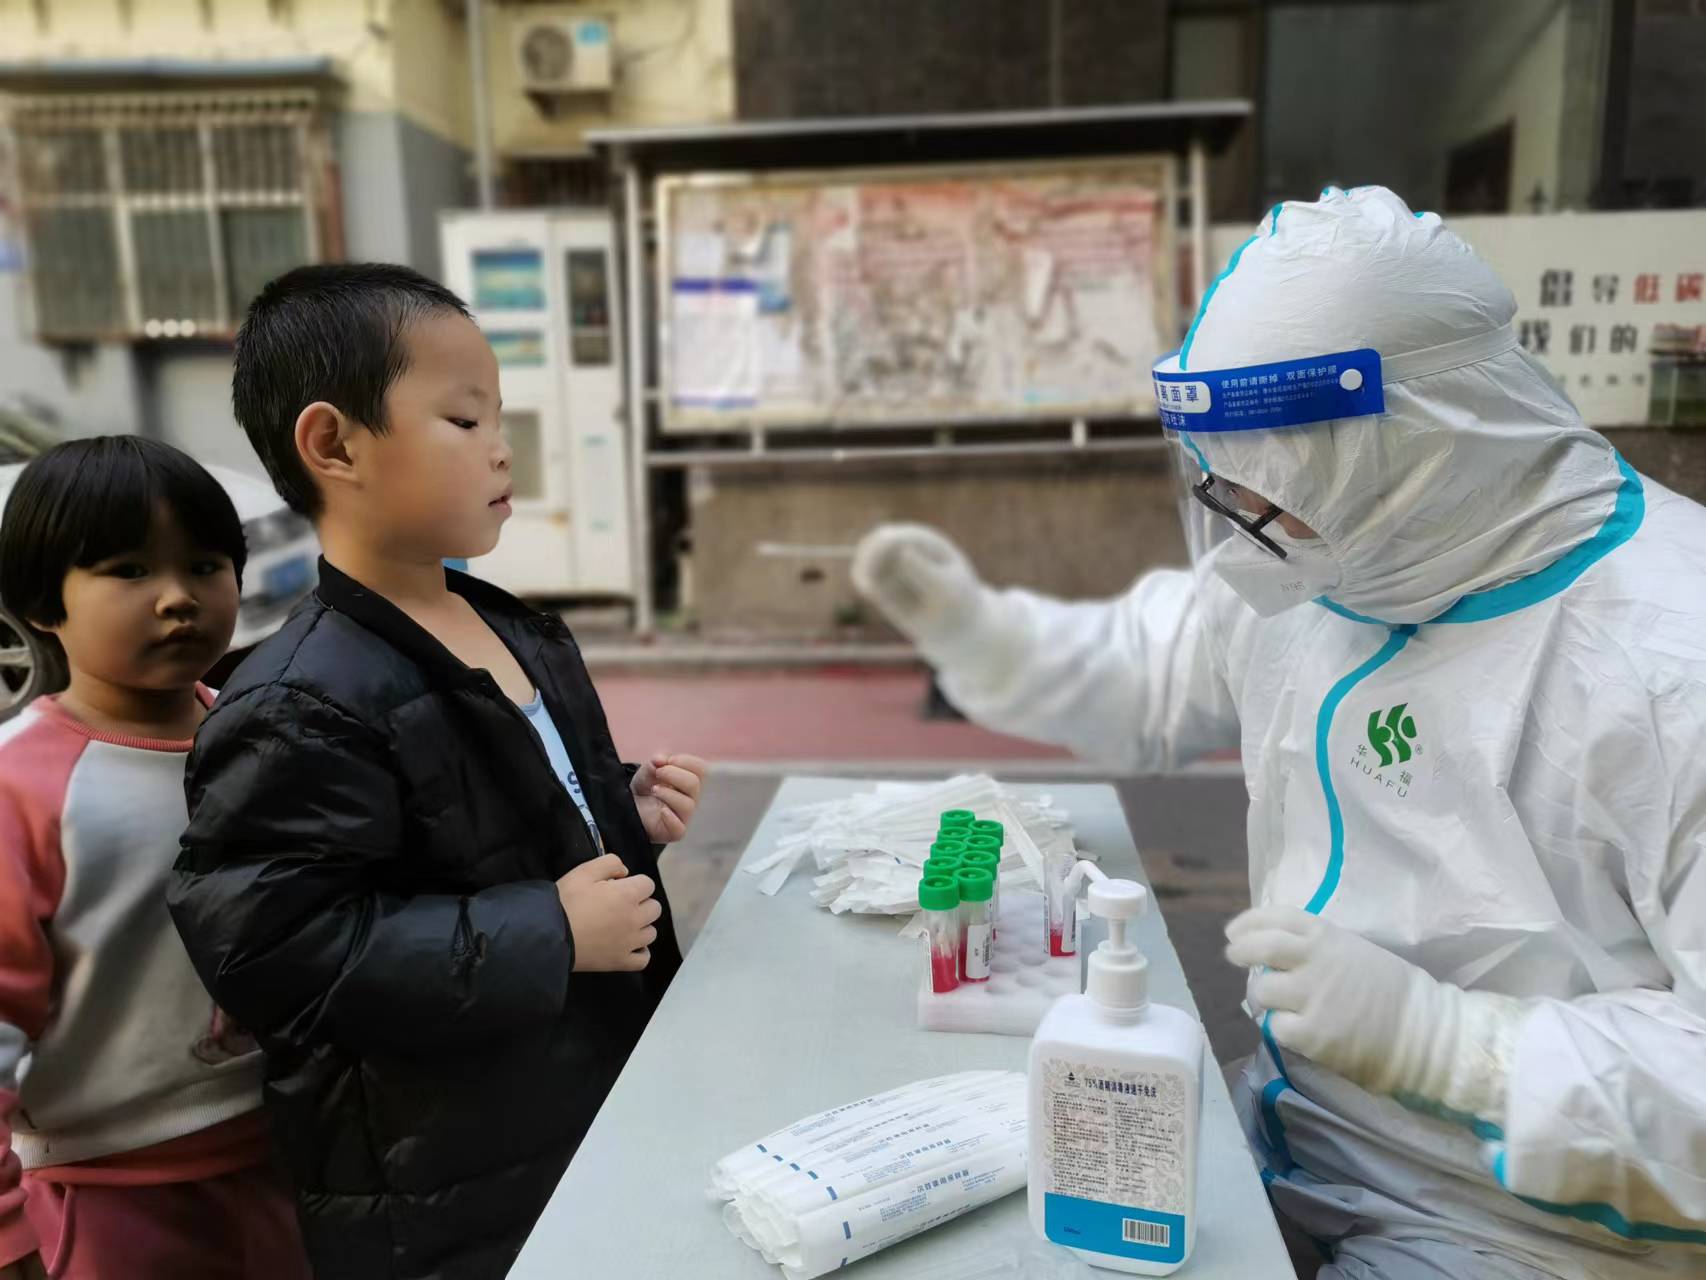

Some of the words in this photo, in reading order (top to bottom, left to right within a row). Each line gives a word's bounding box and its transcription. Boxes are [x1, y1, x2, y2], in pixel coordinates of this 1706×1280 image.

[1156, 384, 1199, 402] 离面罩
[1350, 757, 1407, 797] HUAFU
